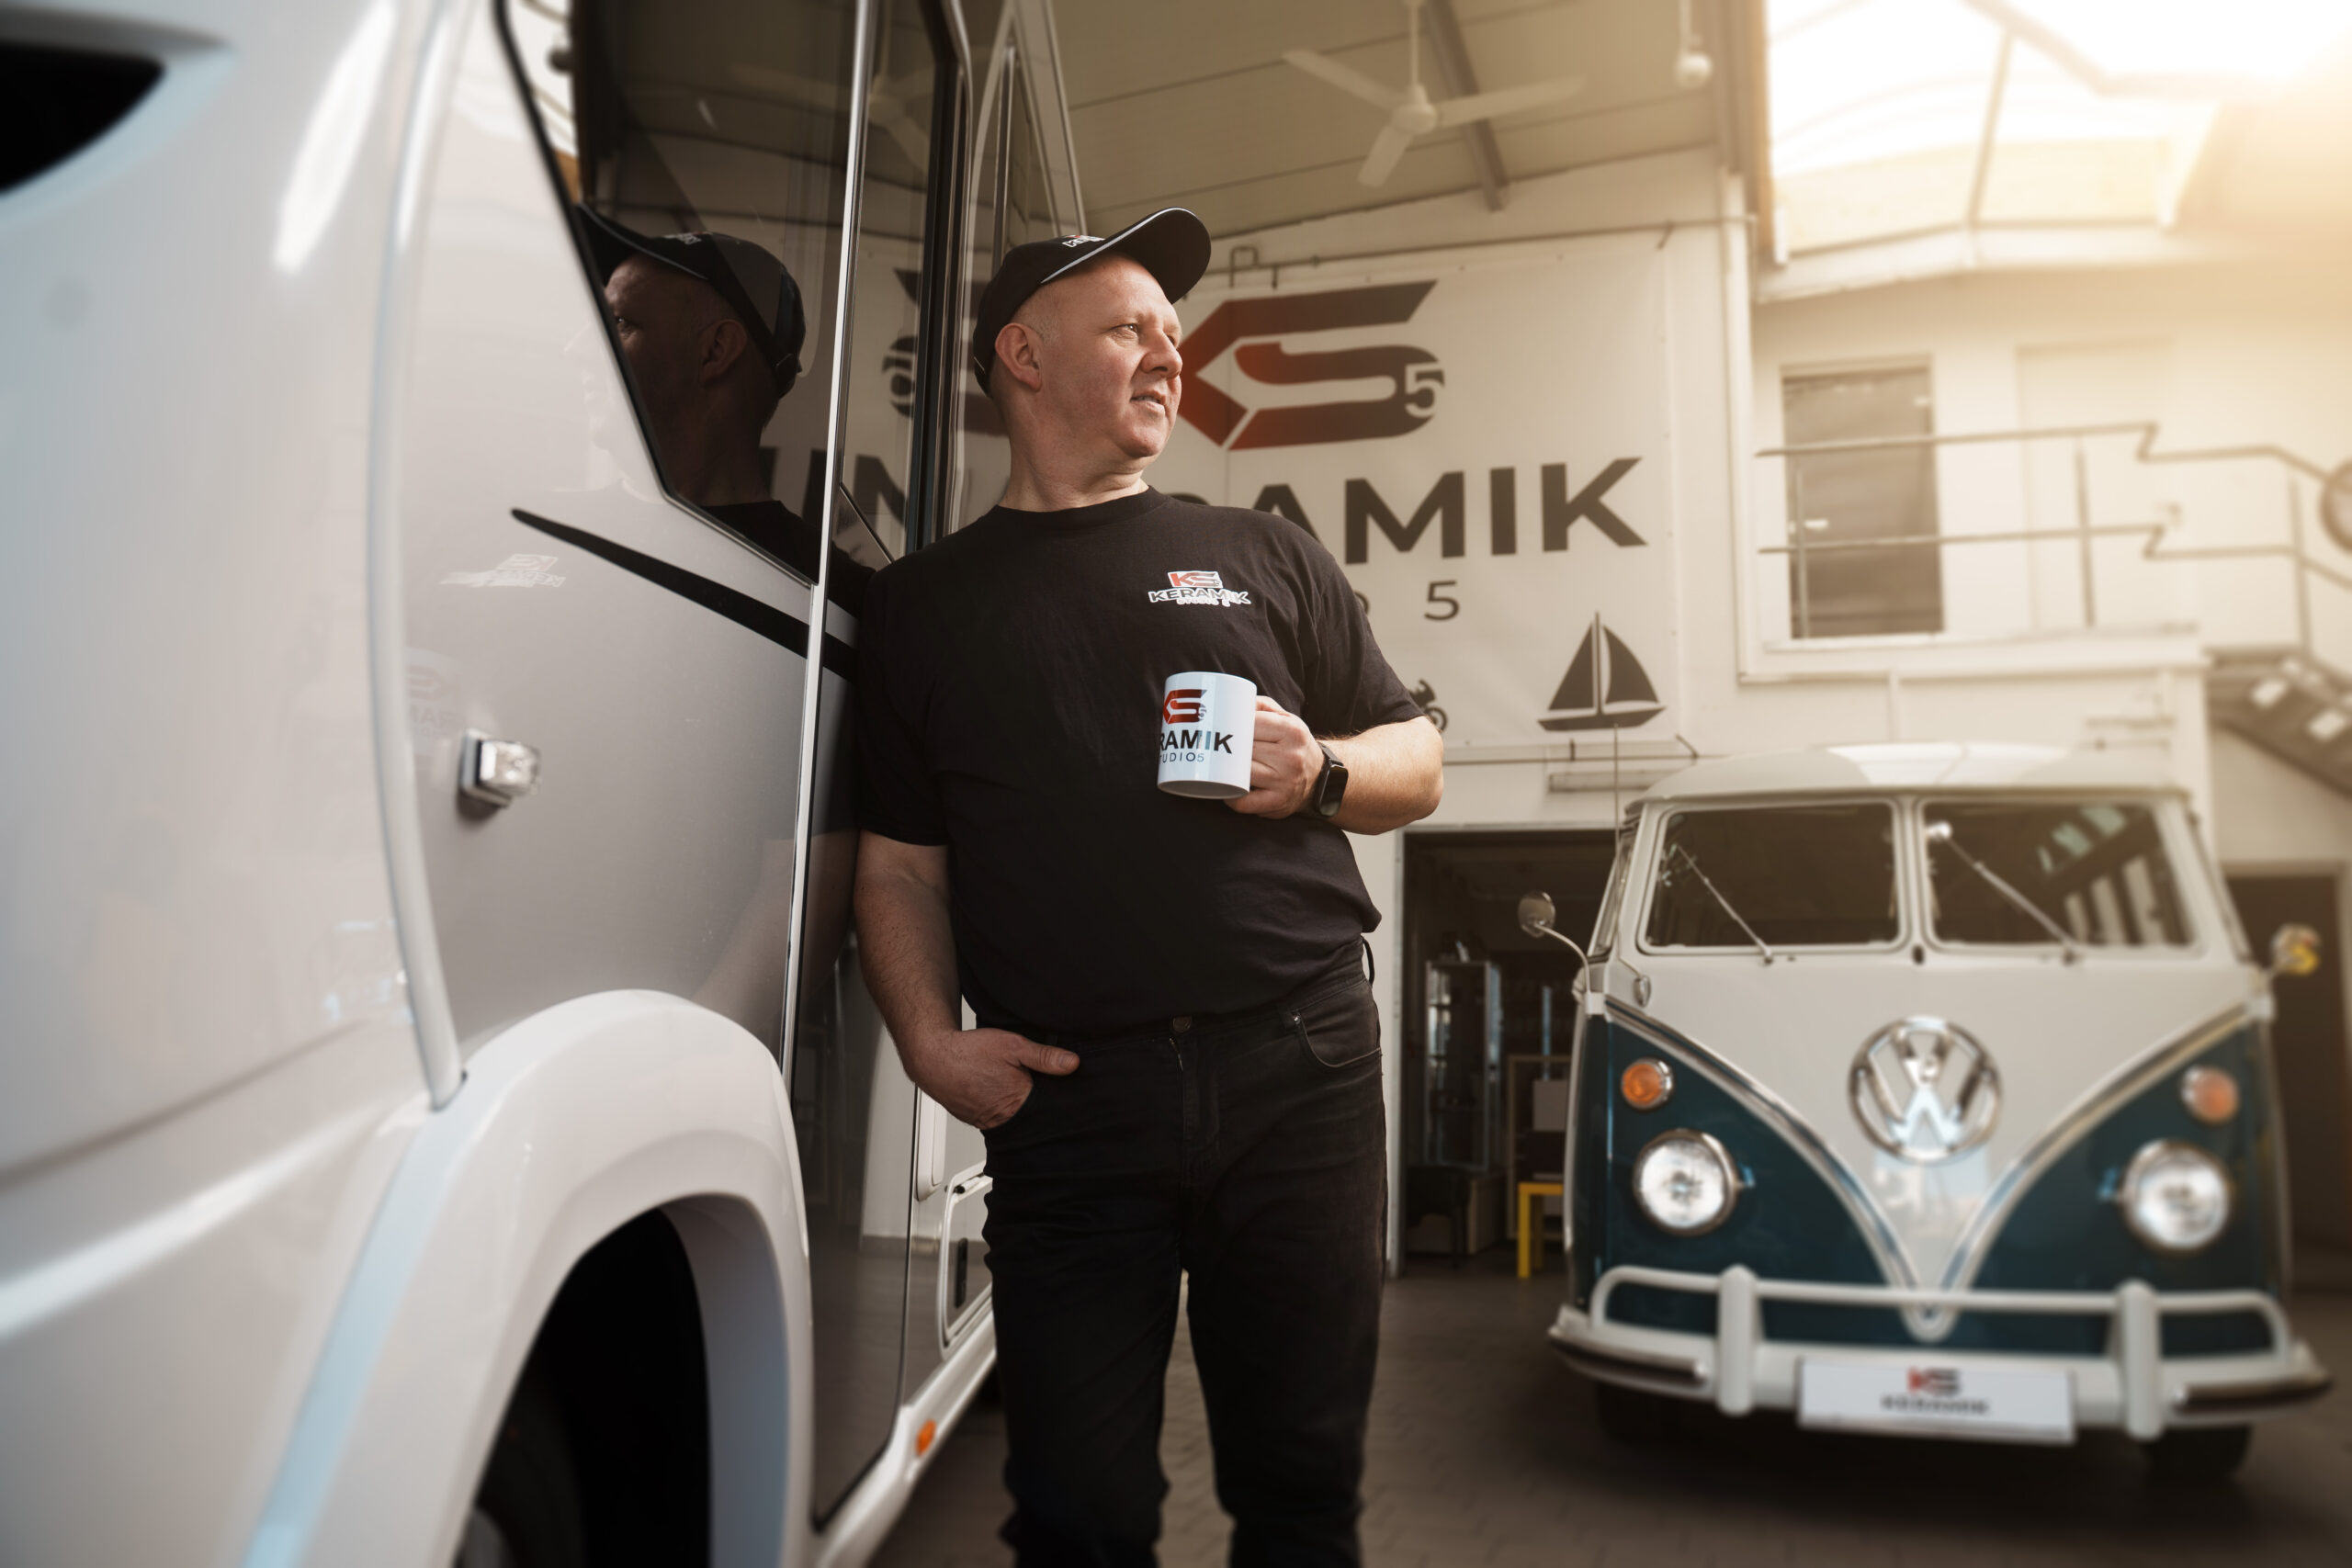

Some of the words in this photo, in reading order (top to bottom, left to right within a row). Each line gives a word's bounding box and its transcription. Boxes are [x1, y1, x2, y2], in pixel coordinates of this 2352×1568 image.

[1163, 457, 1648, 565] AMIK
[1148, 588, 1251, 604] KERAMIK
[1159, 751, 1204, 763] UDIO5
